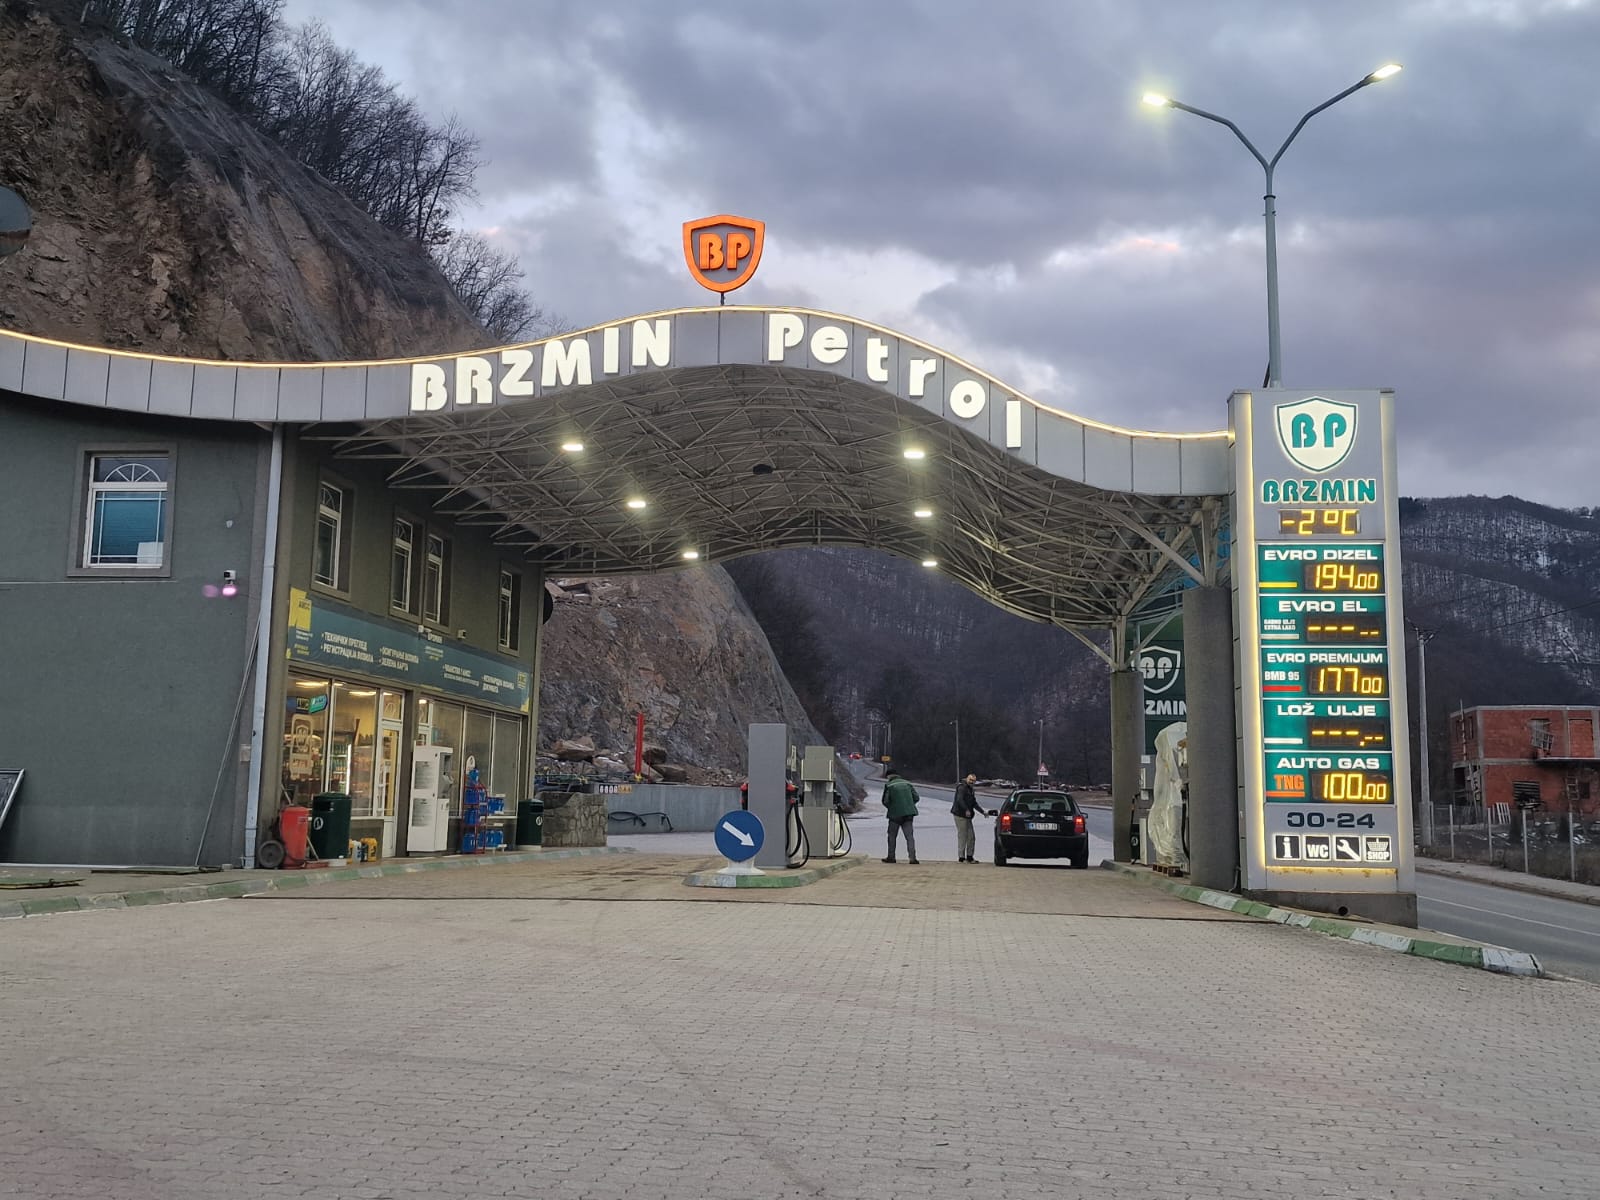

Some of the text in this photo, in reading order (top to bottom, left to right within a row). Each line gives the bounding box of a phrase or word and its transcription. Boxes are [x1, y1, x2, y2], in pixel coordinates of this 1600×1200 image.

[699, 233, 750, 270] BP
[410, 313, 1021, 448] BRZMIN Petrol
[1292, 413, 1347, 448] BP
[1262, 479, 1376, 503] BRZMIN
[1264, 550, 1378, 561] EVRO DIZEL
[1278, 601, 1367, 612] EVRO EL
[1266, 653, 1383, 664] EVRO PREMIJUM
[1140, 656, 1173, 679] BP
[1264, 671, 1300, 681] BMB 95
[1144, 700, 1187, 715] ZMIN
[1277, 702, 1376, 716] LOŽ ULJE
[1277, 758, 1380, 769] AUTO GAS
[1274, 774, 1304, 790] TNG
[1307, 844, 1329, 858] WC
[1367, 851, 1390, 860] SHOP
